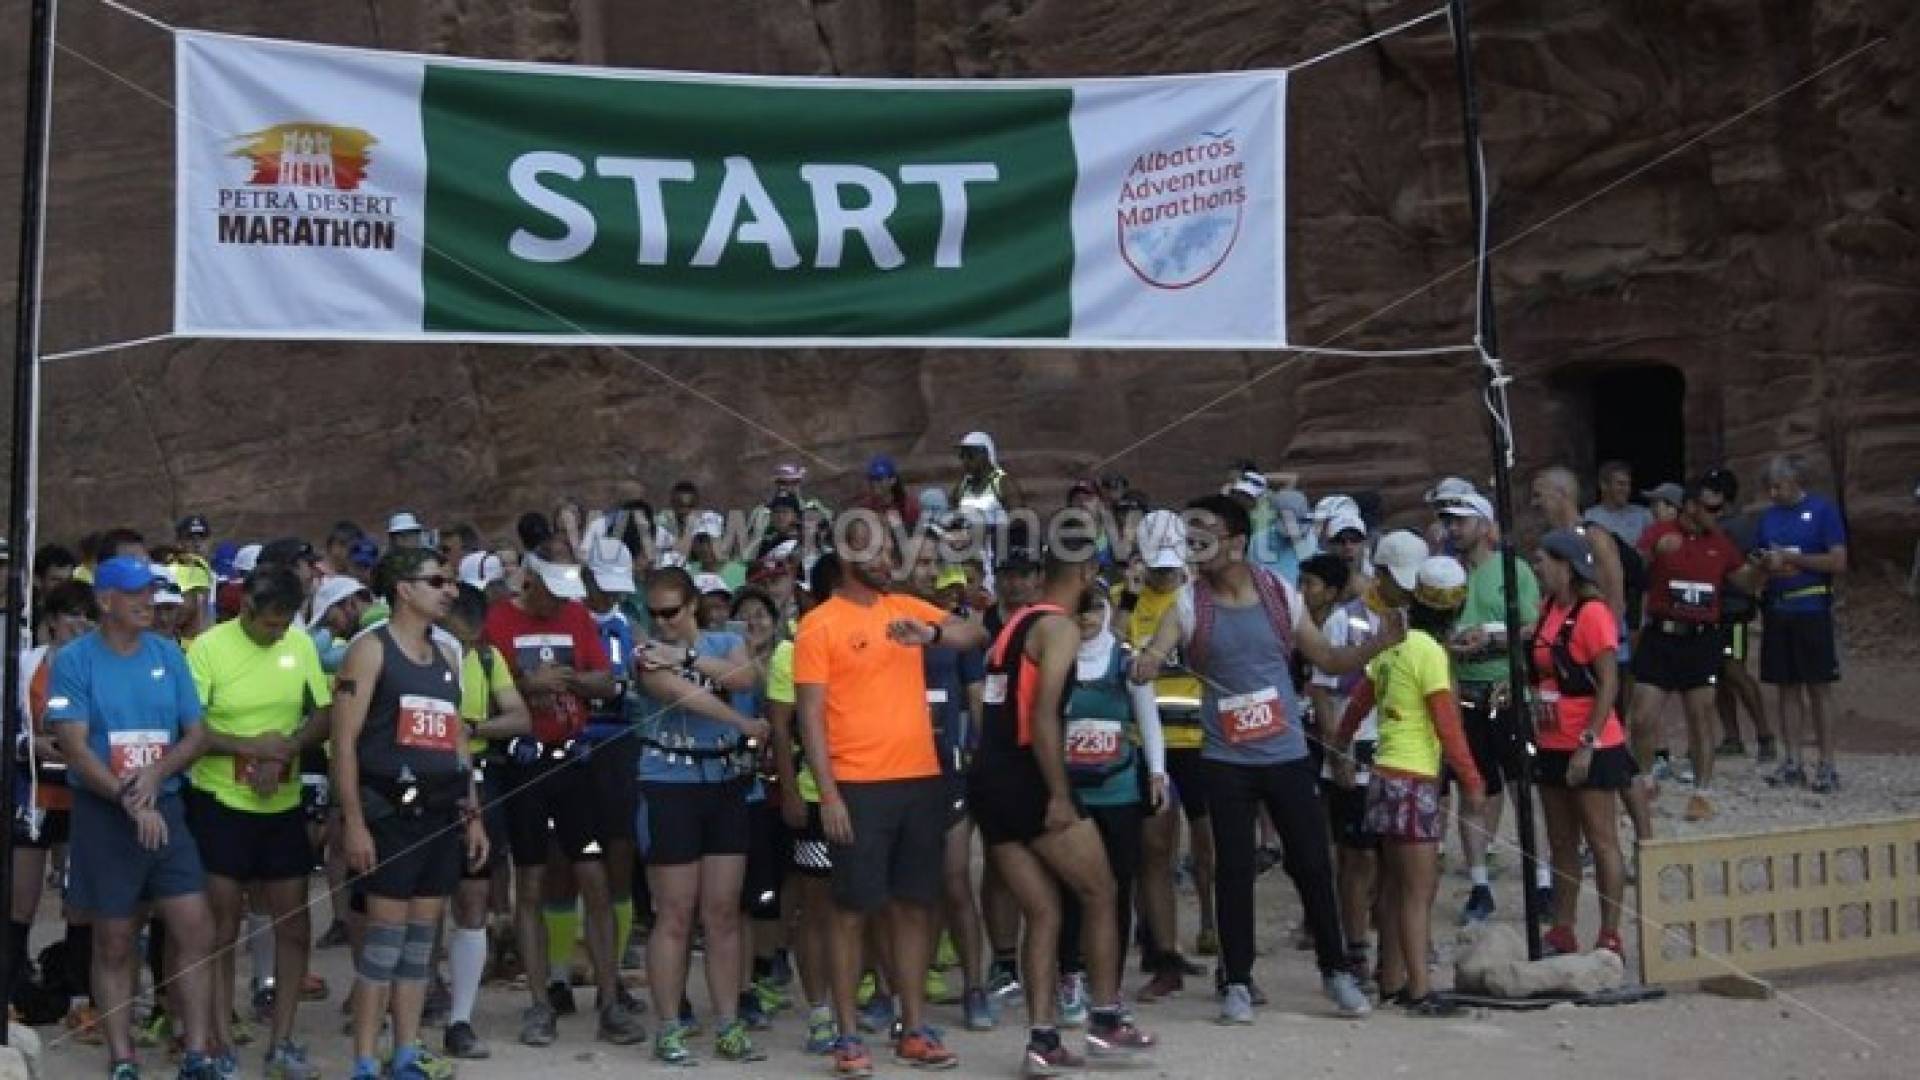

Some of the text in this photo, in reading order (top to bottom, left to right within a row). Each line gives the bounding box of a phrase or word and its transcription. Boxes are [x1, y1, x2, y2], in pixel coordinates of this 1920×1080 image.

[1128, 139, 1235, 177] Albatros
[1118, 161, 1245, 203] Adventure
[218, 188, 397, 215] PETRA DESERT
[508, 150, 999, 270] START
[1117, 185, 1247, 225] Marathons
[218, 214, 396, 250] MARATHON
[412, 711, 447, 738] 316
[1233, 703, 1273, 730] 320
